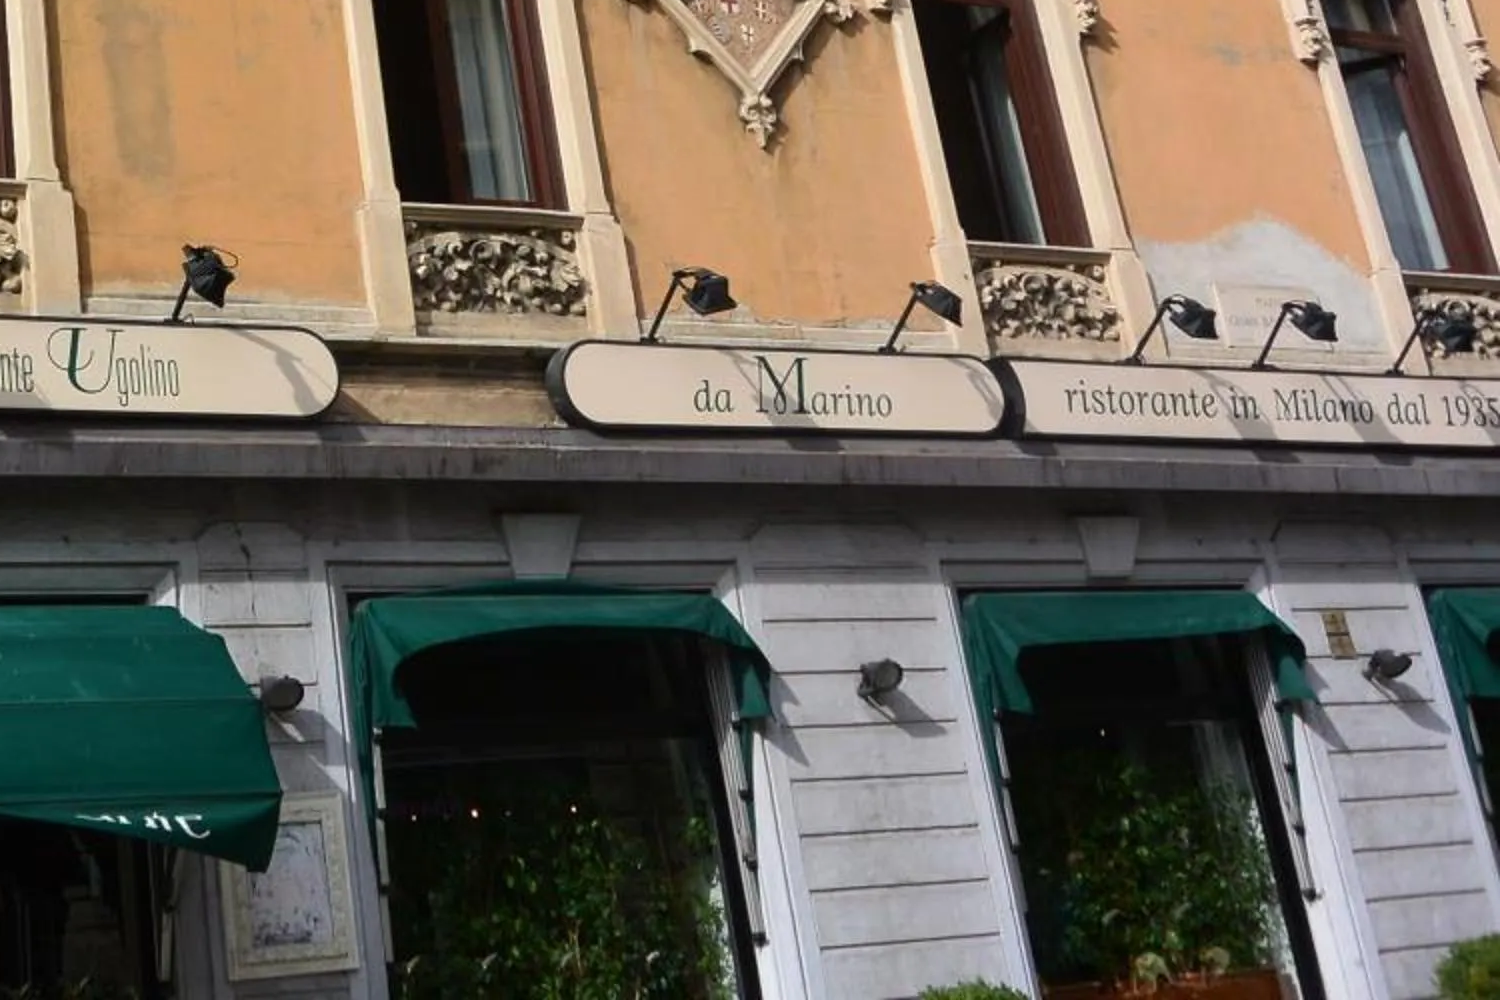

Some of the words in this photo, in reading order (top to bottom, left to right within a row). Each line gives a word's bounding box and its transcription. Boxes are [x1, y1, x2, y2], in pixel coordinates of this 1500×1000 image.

[46, 326, 181, 407] Ugolino
[693, 379, 735, 413] da
[754, 355, 893, 417] Marino
[1064, 379, 1219, 419] ristorante
[1229, 386, 1260, 420] in
[1272, 388, 1374, 426] Milano
[1387, 392, 1432, 426] dal
[1441, 394, 1500, 429] 1935
